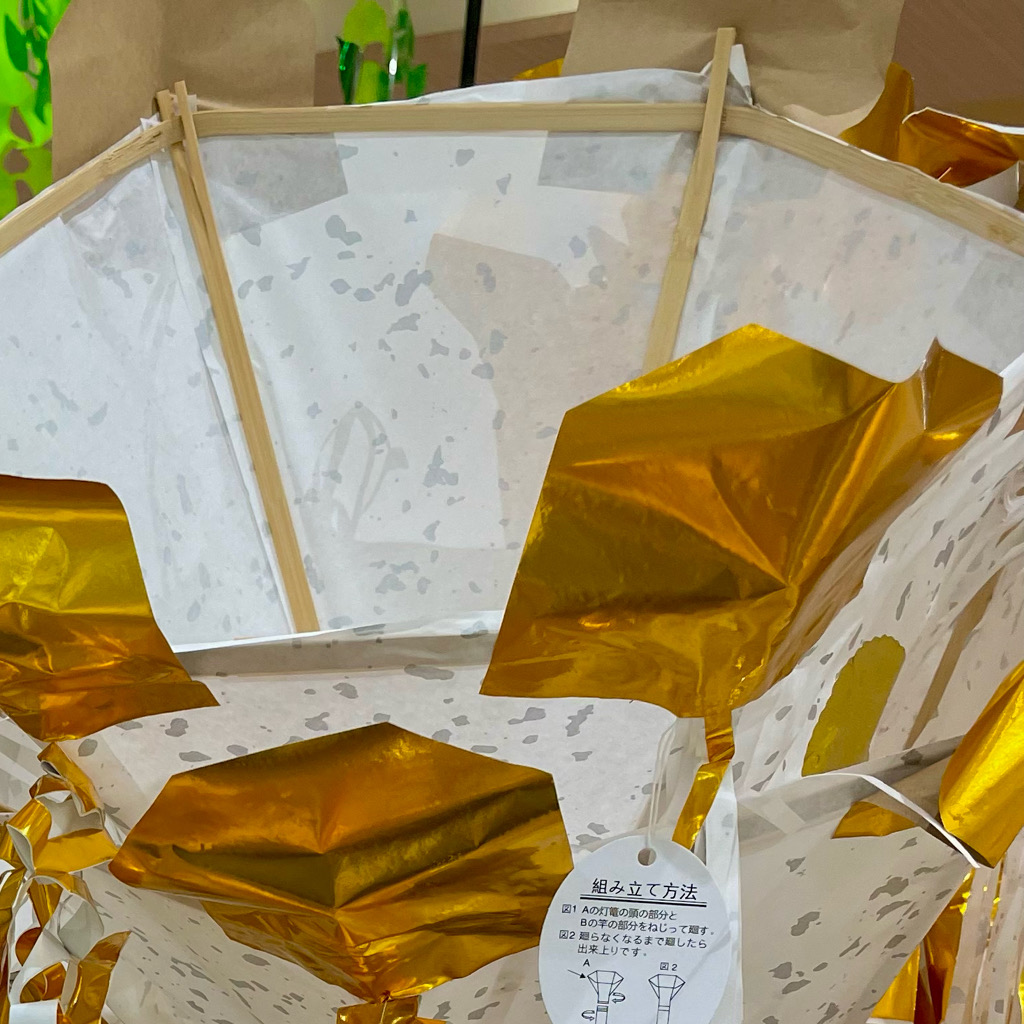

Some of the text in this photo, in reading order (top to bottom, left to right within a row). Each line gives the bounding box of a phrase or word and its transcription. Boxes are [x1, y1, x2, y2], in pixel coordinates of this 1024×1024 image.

[592, 878, 697, 900] 組み立て方法
[582, 958, 591, 967] A
